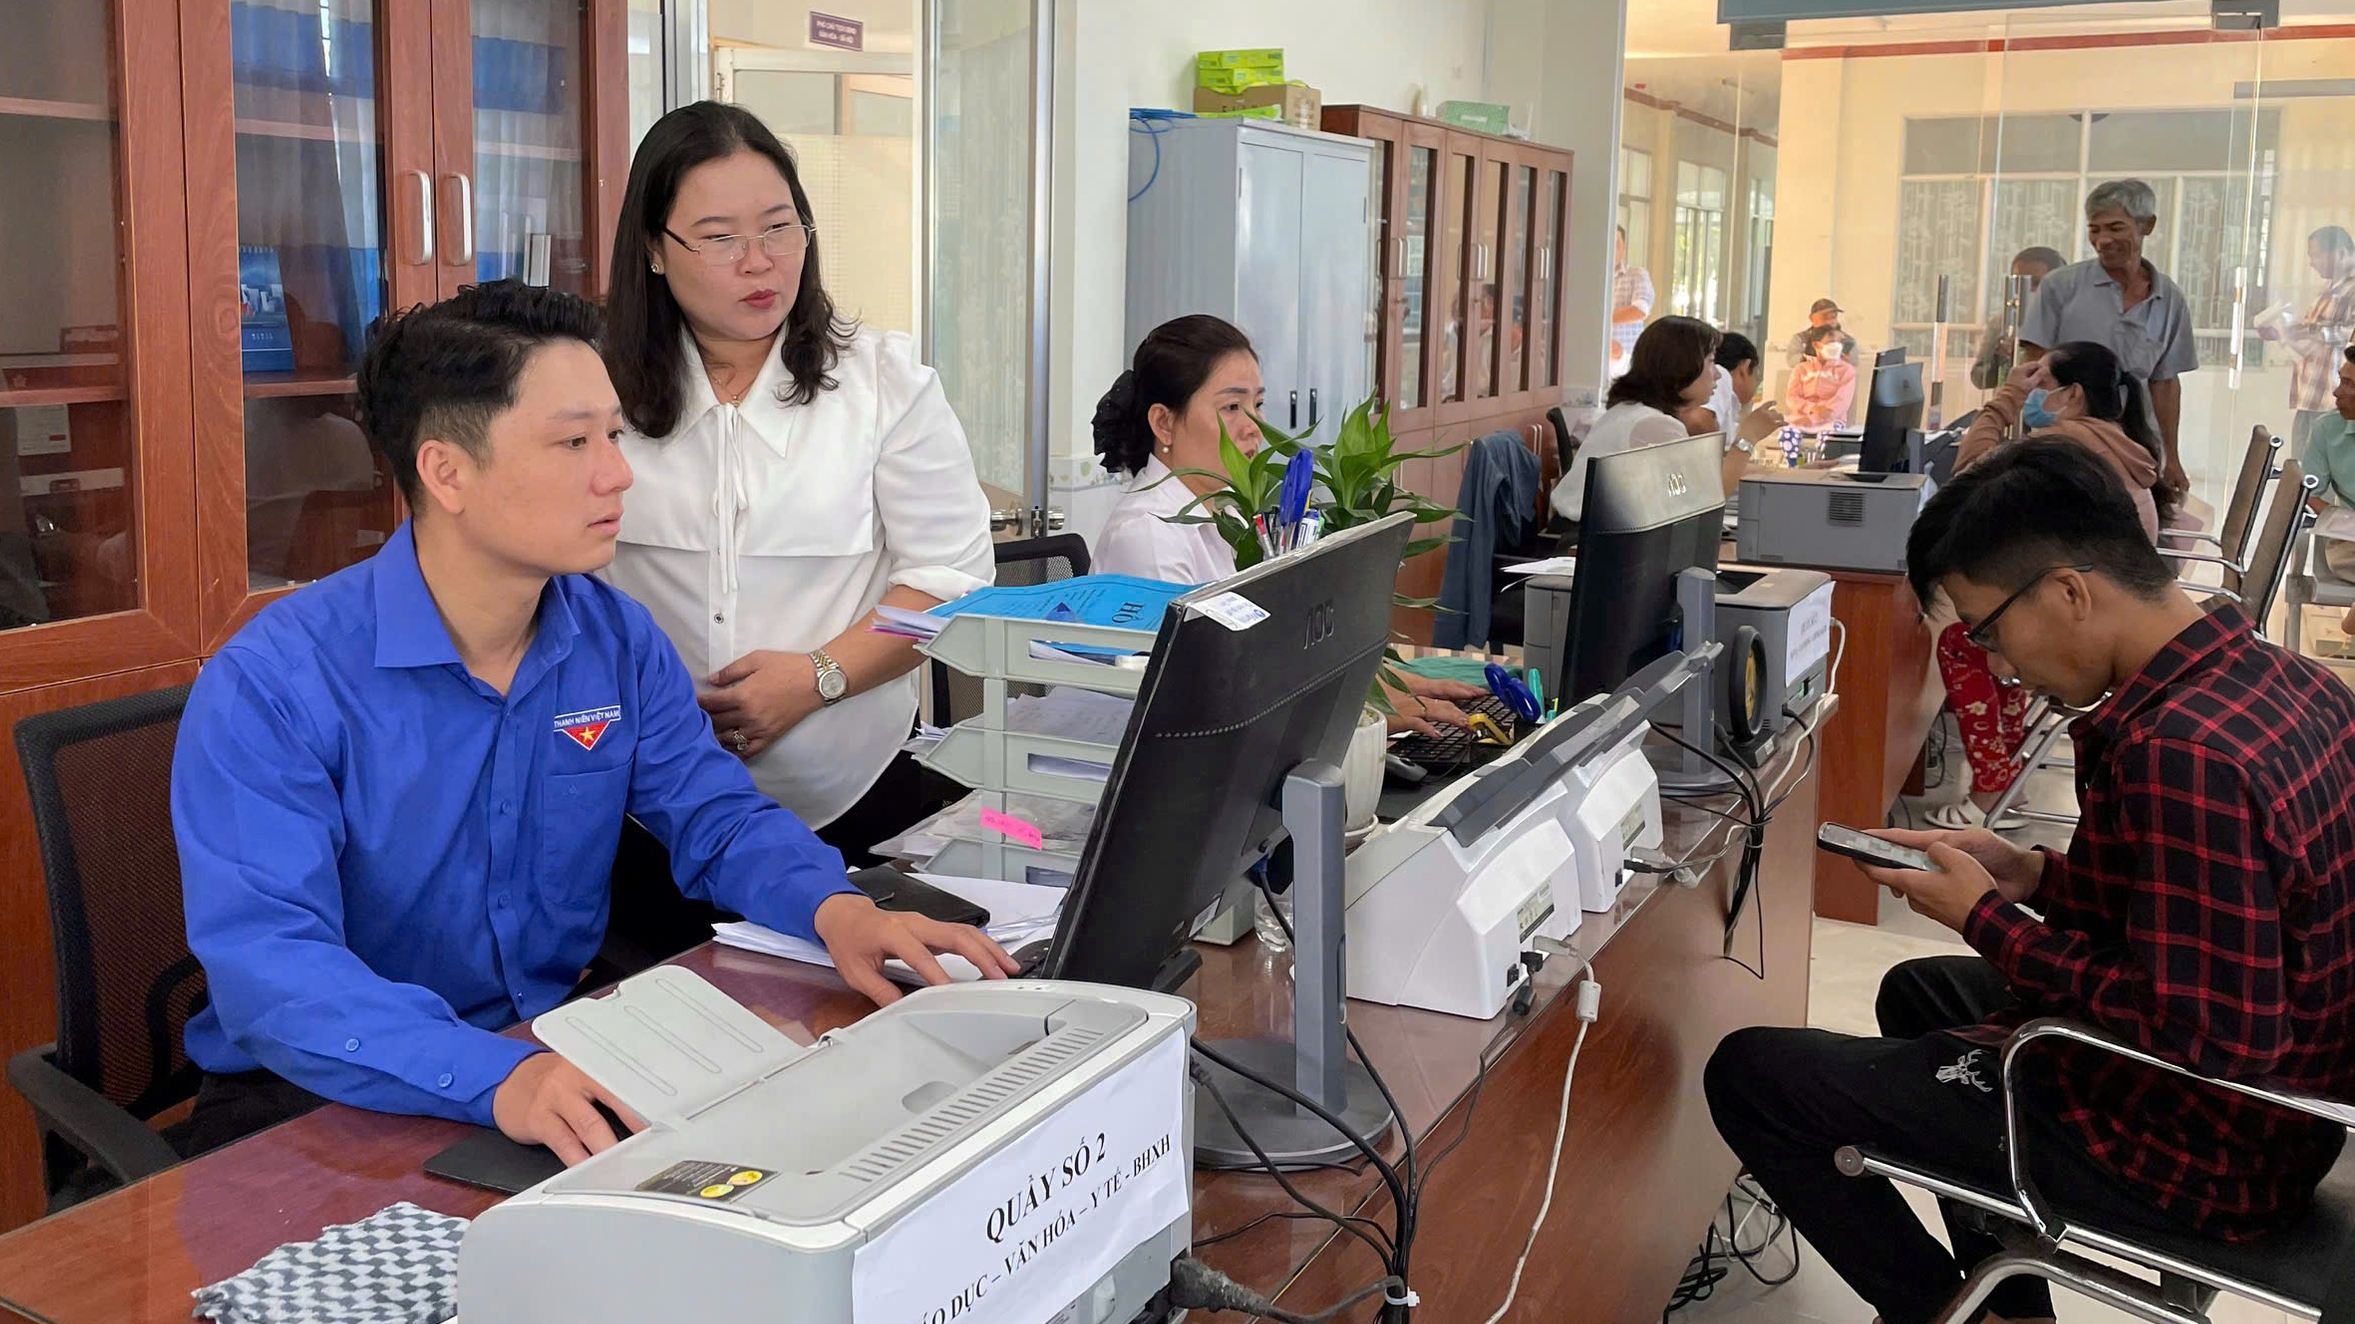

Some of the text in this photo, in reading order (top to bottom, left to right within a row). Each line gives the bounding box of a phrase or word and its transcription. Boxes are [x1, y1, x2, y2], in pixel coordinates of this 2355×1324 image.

[554, 709, 620, 728] THANH NIÊN VIỆT NAM
[1062, 1136, 1090, 1189] SỐ
[1096, 1132, 1105, 1163] 2
[951, 1273, 988, 1320] DỤC
[1004, 1233, 1039, 1275] VĂN
[1043, 1209, 1075, 1248] HÓA
[1091, 1186, 1101, 1209] Y
[1104, 1166, 1122, 1200] TẾ
[1133, 1133, 1171, 1177] BHXH
